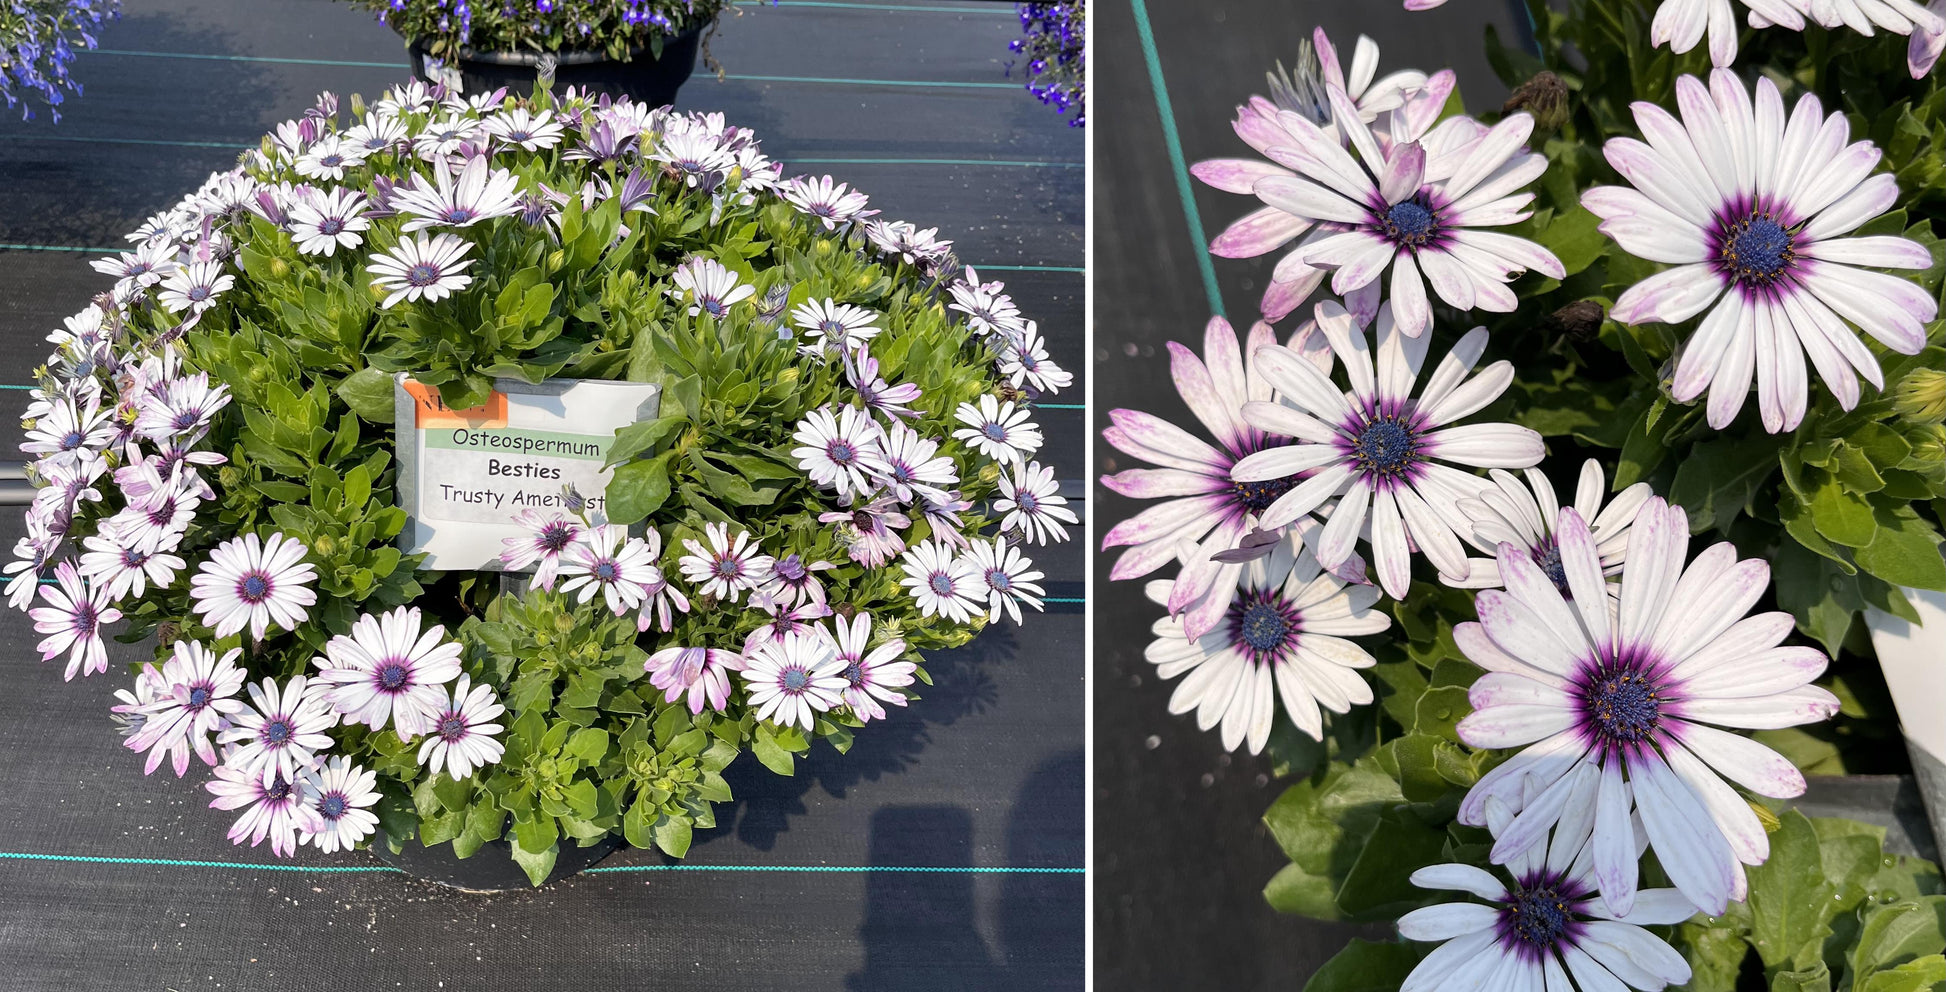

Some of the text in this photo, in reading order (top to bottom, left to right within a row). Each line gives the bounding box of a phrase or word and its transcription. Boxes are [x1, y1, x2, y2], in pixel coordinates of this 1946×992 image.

[453, 428, 600, 457] Osteospermum
[488, 458, 561, 480] Besties
[440, 484, 505, 510] Trusty
